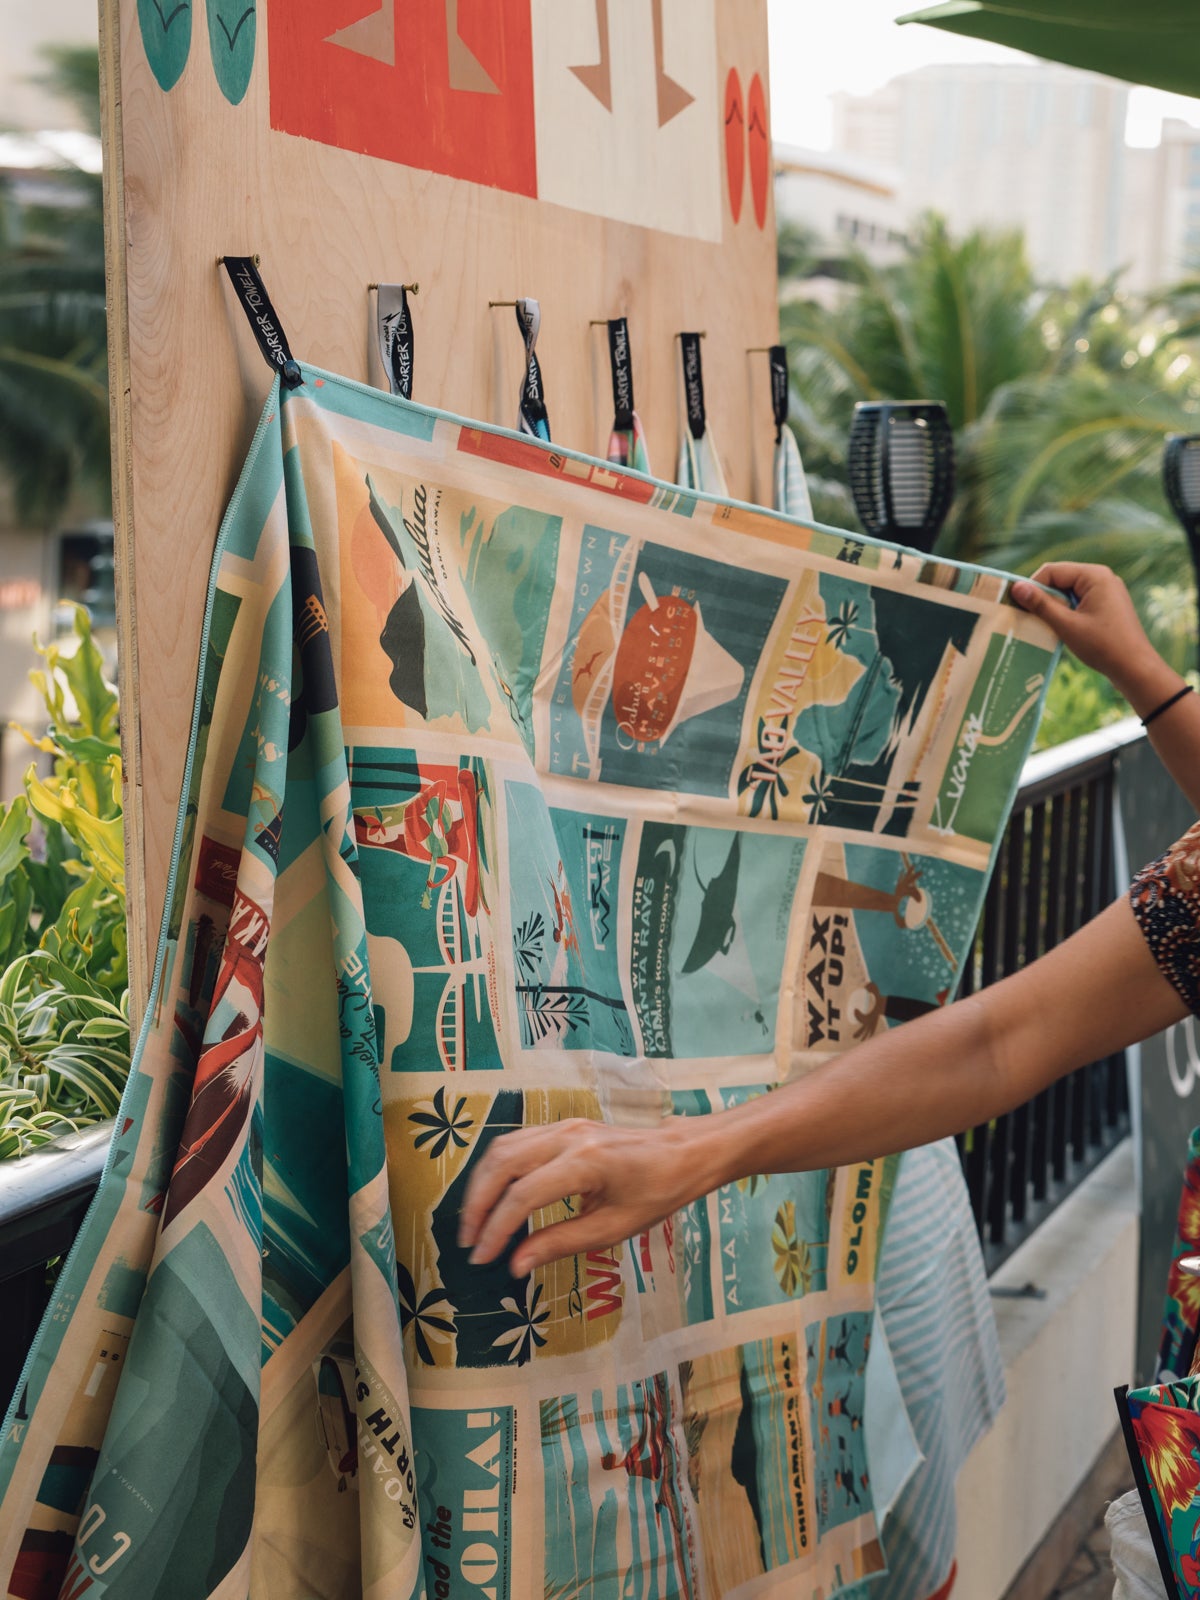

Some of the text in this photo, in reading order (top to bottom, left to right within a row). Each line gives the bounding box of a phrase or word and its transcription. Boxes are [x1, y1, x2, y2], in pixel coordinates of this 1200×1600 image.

[236, 261, 288, 366] SURFER TOWEL
[396, 341, 410, 395] SURFER
[612, 321, 630, 410] SURFER TOWEL
[684, 339, 701, 420] SURFER TOWEL
[434, 489, 443, 536] HAWAII
[552, 535, 596, 765] HALEIWA TOWN
[636, 585, 682, 753] SHAVE ICE
[642, 640, 660, 694] BEST
[650, 589, 697, 755] SURF RIDING
[766, 605, 826, 719] VALLEY
[615, 681, 642, 750] Oahu's
[633, 875, 645, 920] THE
[659, 881, 672, 935] COAST
[631, 931, 640, 989] WITH
[638, 876, 657, 1054] MANTA RAYS
[654, 938, 665, 982] KONA
[807, 912, 832, 1049] WAX
[827, 914, 849, 1043] IT UP!
[723, 1237, 741, 1307] ALA
[781, 1341, 793, 1388] HAT
[787, 1396, 808, 1549] CHINAMAN'S
[429, 1505, 453, 1550] the
